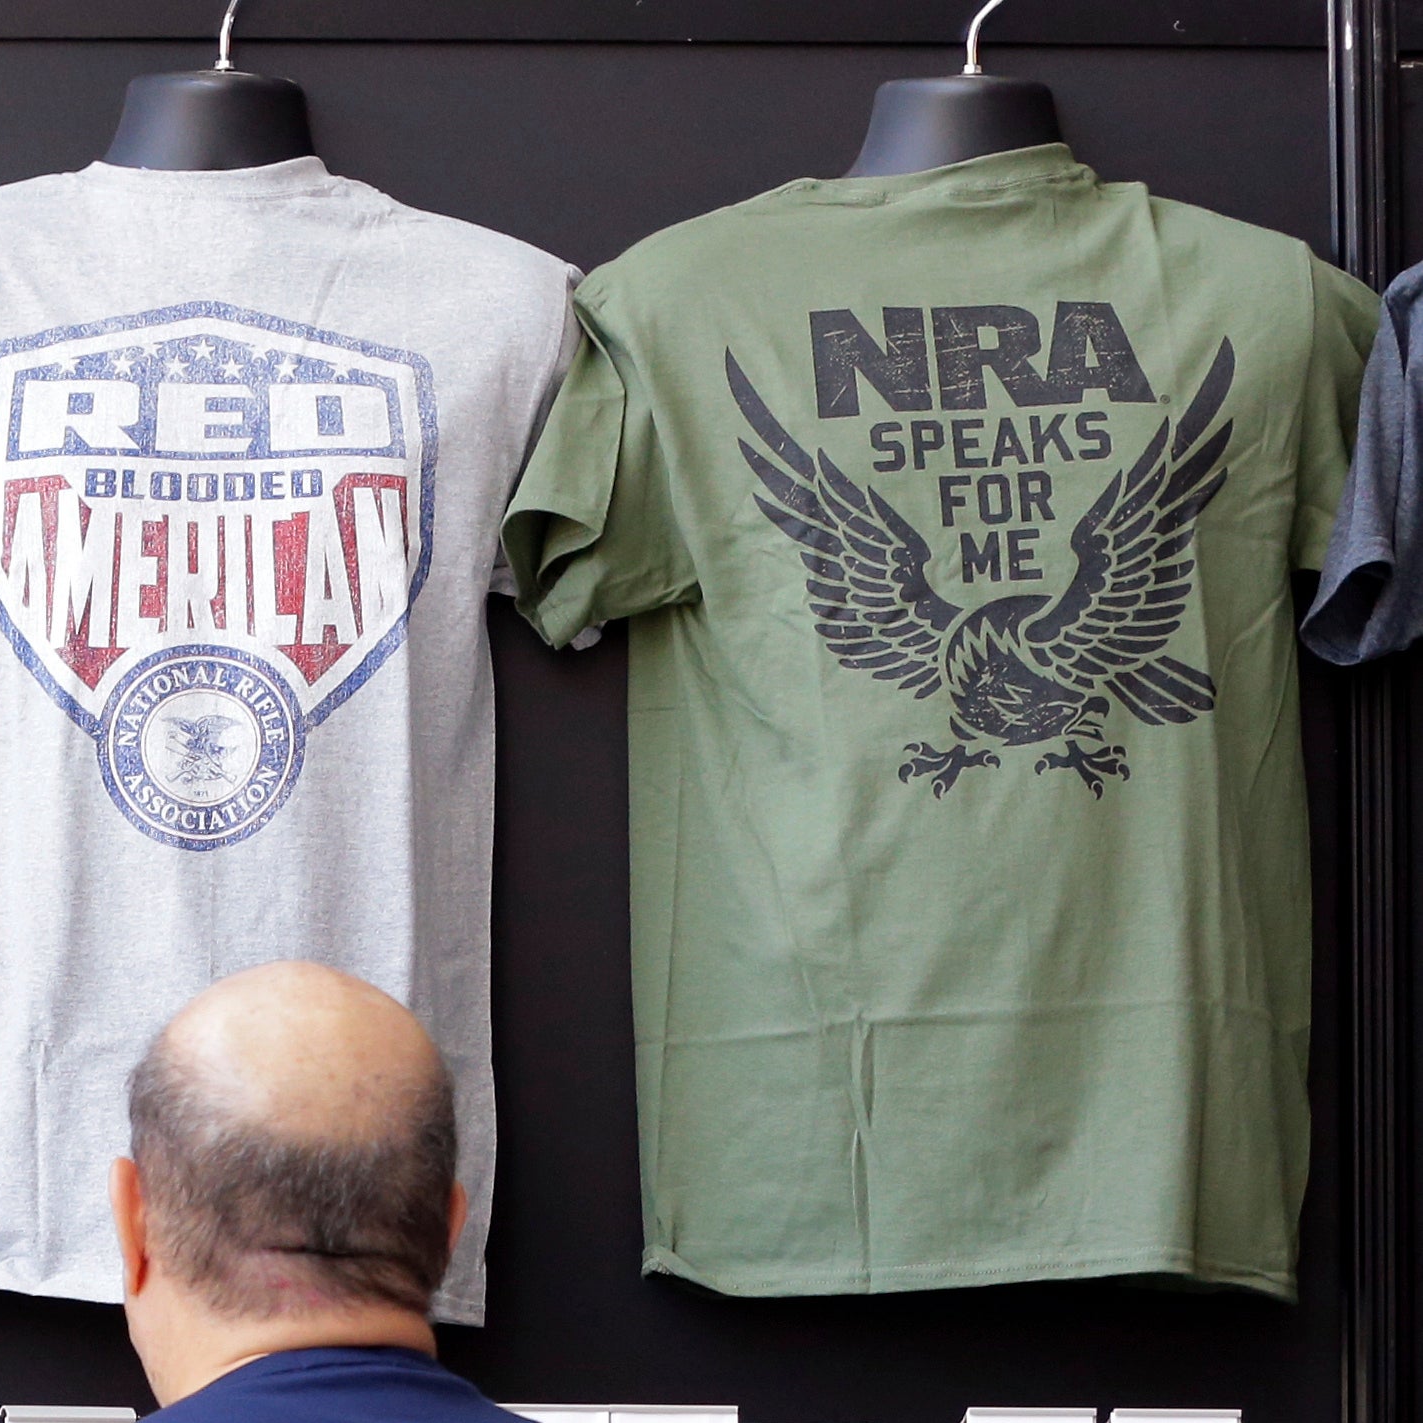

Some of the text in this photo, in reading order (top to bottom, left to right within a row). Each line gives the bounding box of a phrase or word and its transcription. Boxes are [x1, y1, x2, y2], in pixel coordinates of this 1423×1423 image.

[809, 300, 1158, 419] NRA
[18, 379, 394, 453] RED
[869, 410, 1112, 473] SPEAKS
[85, 468, 325, 502] BLOODED
[939, 470, 1056, 527] FOR
[2, 480, 410, 649] AMERICAN
[960, 528, 1043, 584] ME
[118, 665, 285, 747] NATIONAL RIFLE
[124, 765, 278, 830] ASSOCIATION
